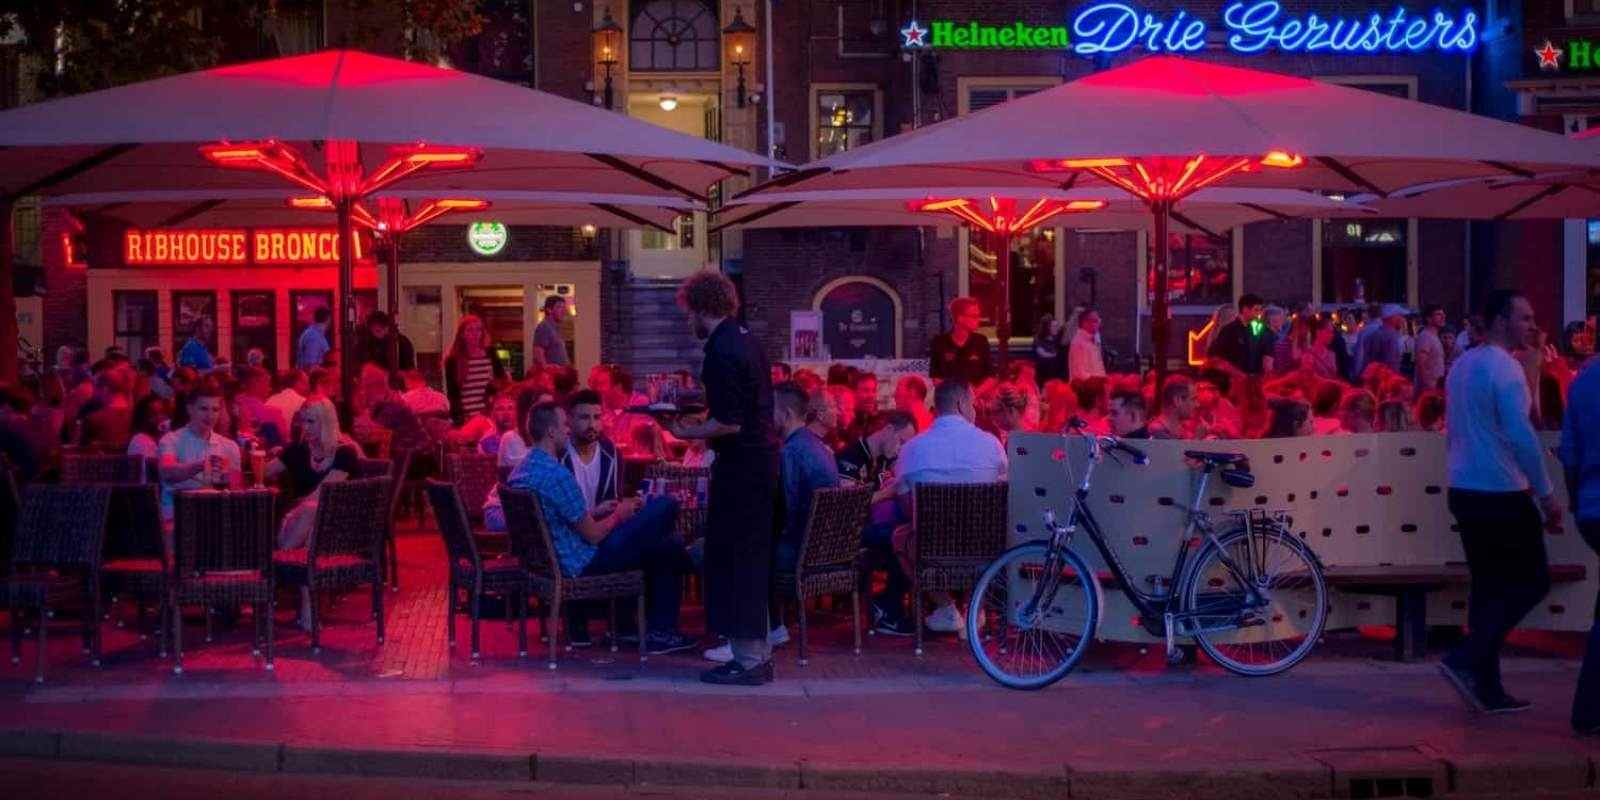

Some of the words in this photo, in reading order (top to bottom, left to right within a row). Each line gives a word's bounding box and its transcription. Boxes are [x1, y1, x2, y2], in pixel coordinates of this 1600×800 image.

[931, 22, 1068, 47] Heineken
[1074, 3, 1205, 53] Drie
[1225, 1, 1476, 51] Gezusters
[127, 233, 246, 260] RIBHOUSE
